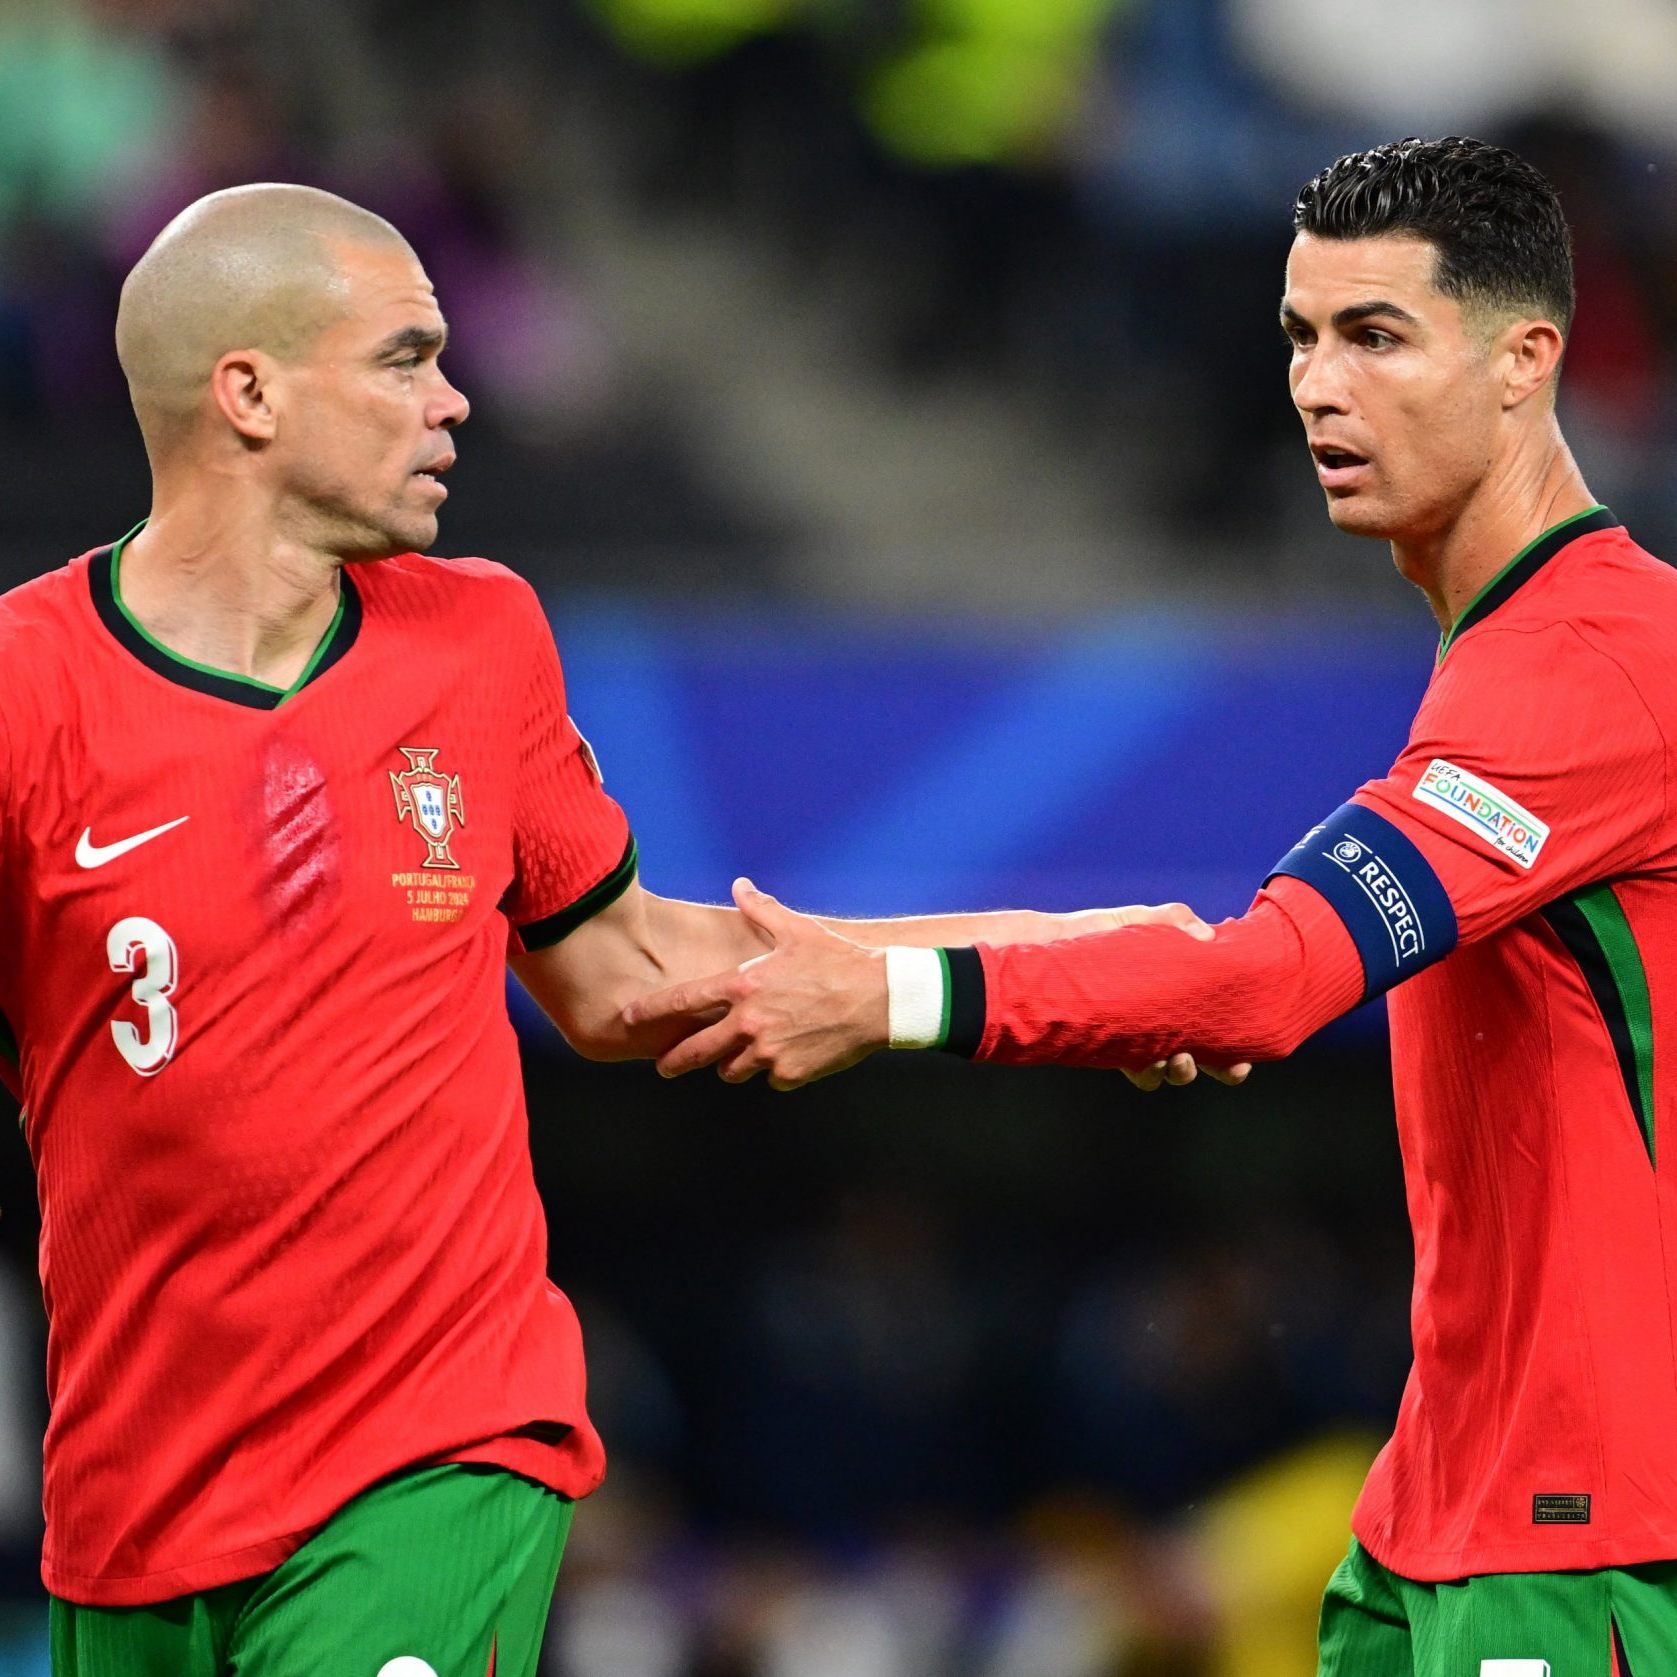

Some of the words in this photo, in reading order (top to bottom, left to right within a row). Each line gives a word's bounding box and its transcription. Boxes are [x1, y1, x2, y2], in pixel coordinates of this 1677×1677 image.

[1430, 763, 1460, 781] UEFA
[1495, 836, 1505, 847] for
[1506, 845, 1529, 864] children
[406, 890, 413, 904] 5
[415, 890, 446, 905] JULHO
[1359, 861, 1419, 958] RESPECT
[106, 916, 178, 1077] 3
